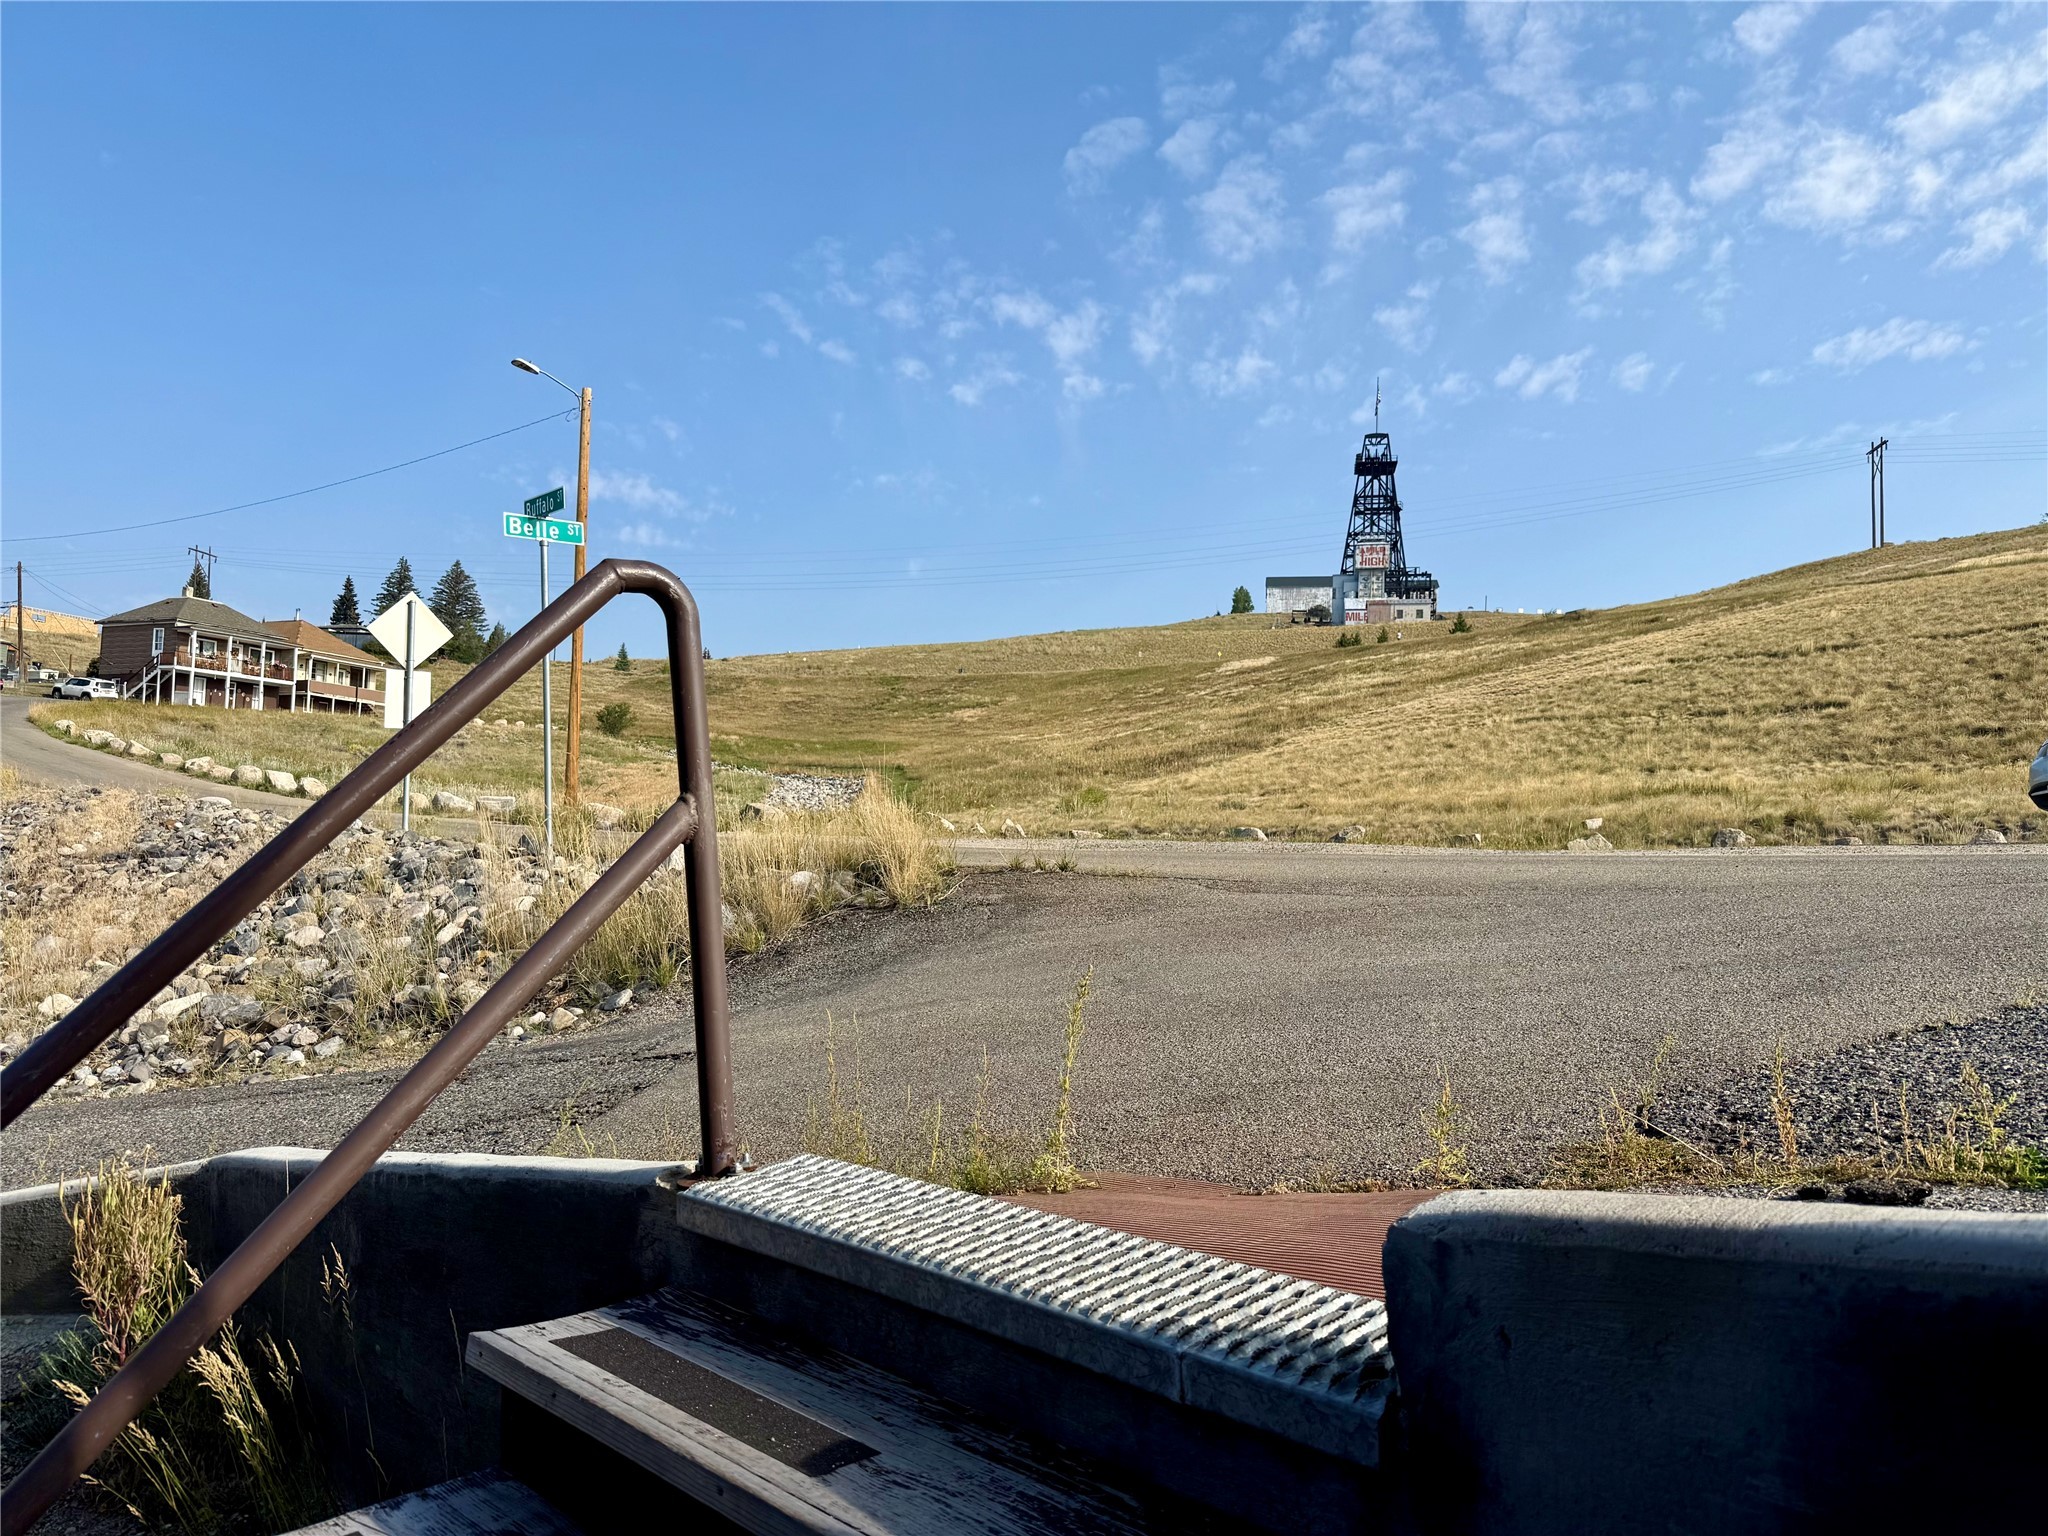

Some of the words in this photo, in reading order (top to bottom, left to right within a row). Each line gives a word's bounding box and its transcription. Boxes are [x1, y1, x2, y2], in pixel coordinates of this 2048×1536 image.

[525, 496, 554, 517] Buffalo
[557, 490, 563, 502] ST
[509, 517, 560, 539] Belle
[567, 524, 581, 537] ST
[1361, 557, 1384, 566] HIGH
